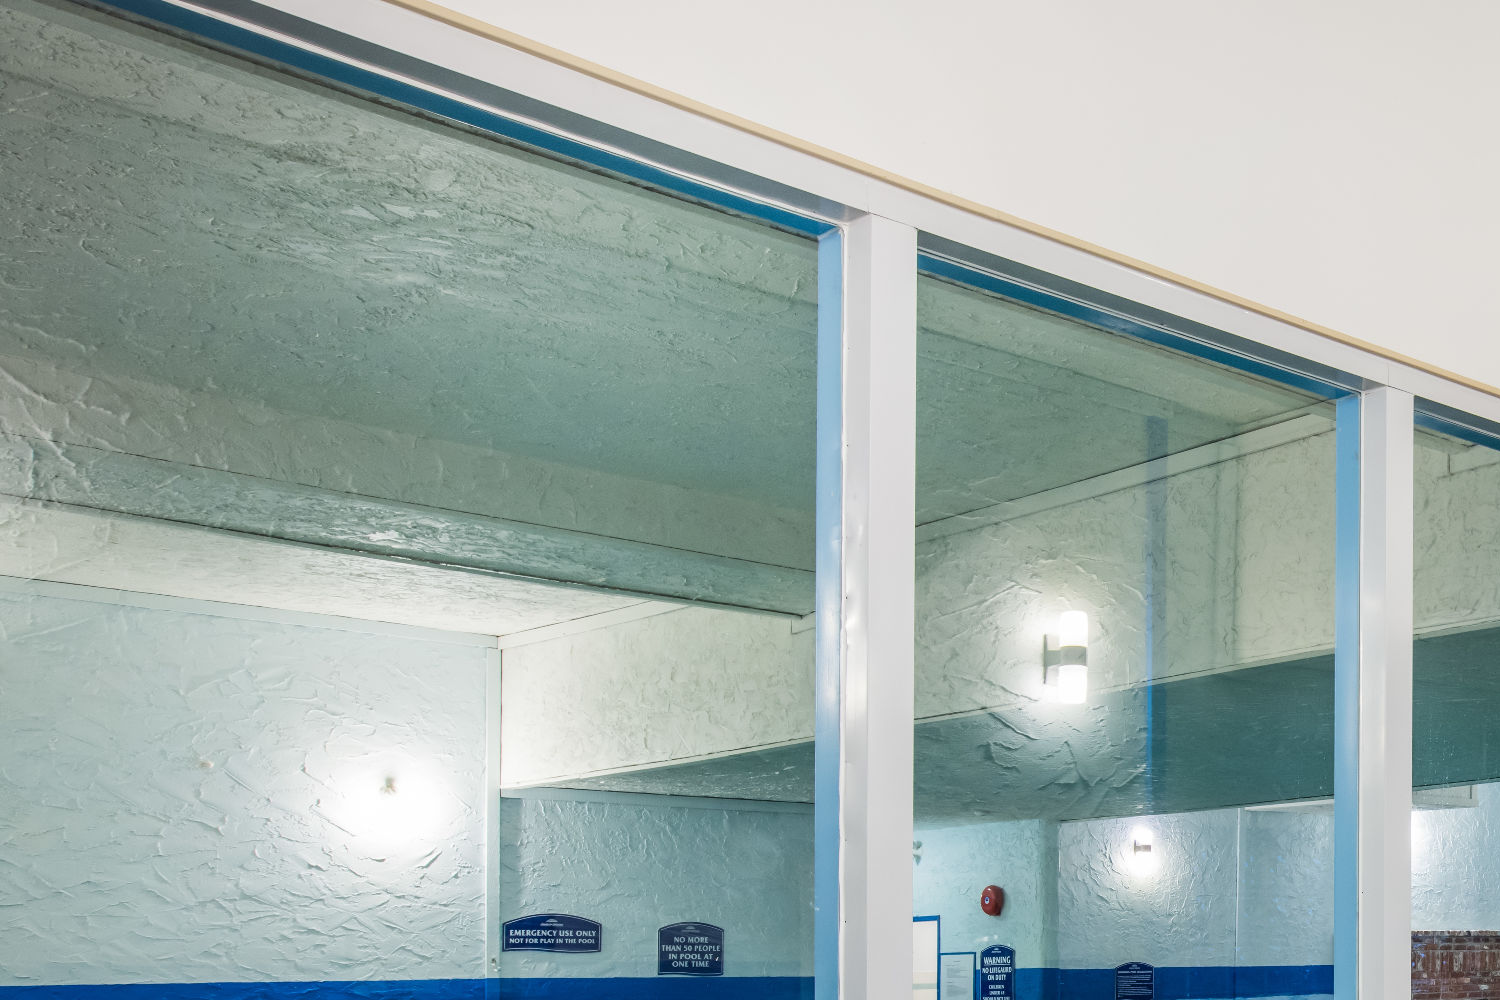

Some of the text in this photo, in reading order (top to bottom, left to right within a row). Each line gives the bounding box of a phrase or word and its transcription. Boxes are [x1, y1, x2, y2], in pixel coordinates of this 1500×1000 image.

[509, 929, 557, 937] EMERGENCY
[661, 944, 682, 952] THAN
[694, 944, 721, 952] PEOPLE
[671, 960, 710, 968] ONE TIME
[984, 956, 1011, 964] WARNING
